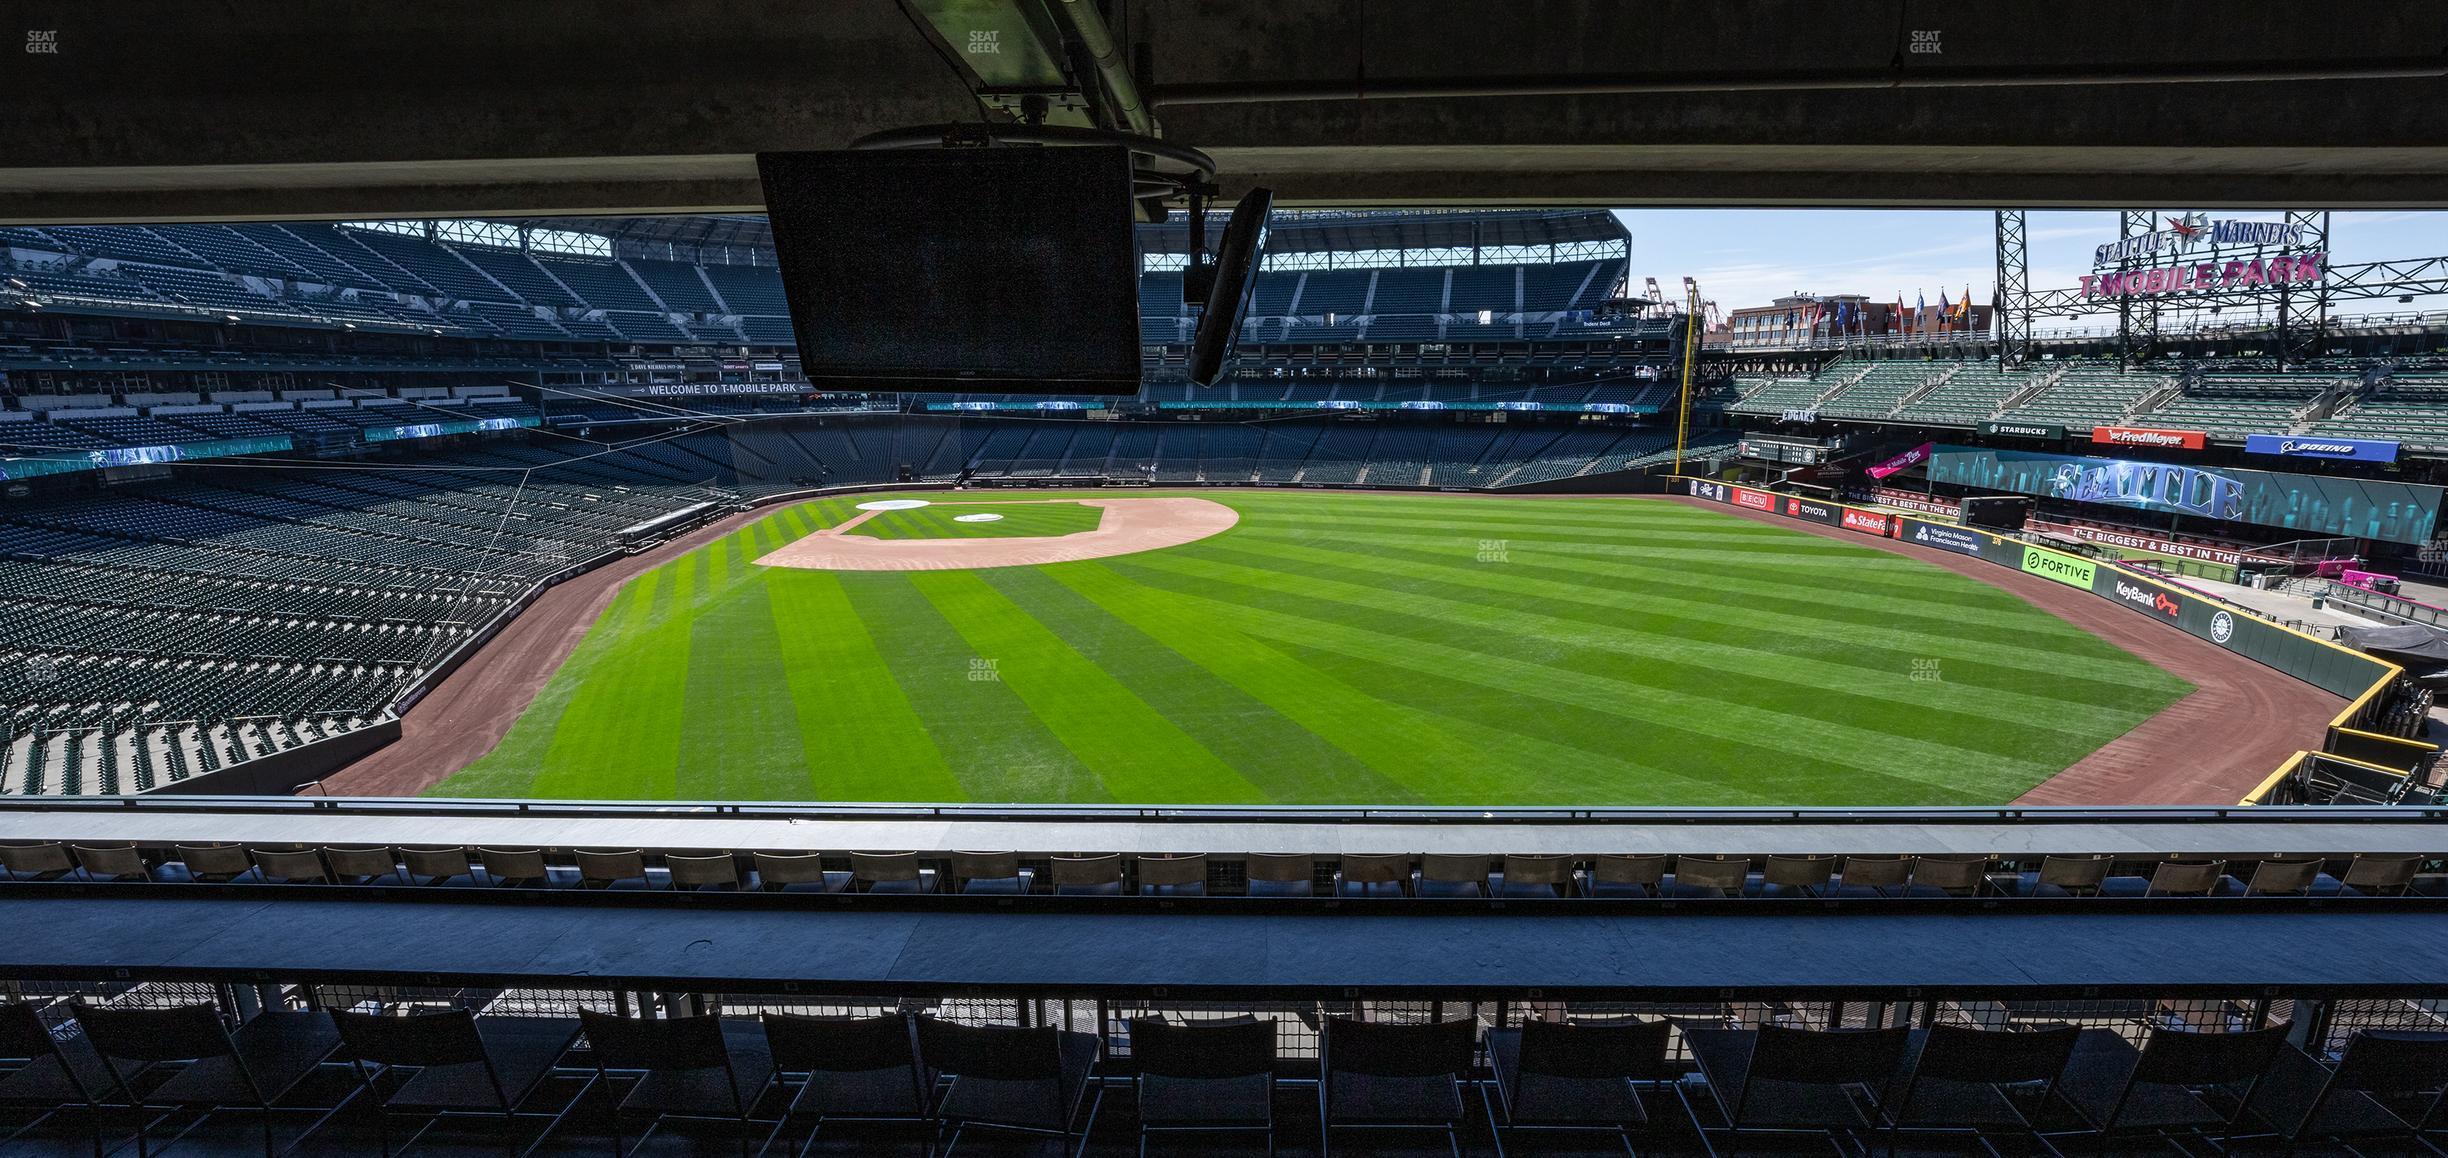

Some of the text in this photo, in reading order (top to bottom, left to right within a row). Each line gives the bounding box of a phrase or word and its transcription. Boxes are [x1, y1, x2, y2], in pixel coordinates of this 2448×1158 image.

[2095, 218, 2305, 265] SEATTLE MARINERS
[2079, 251, 2330, 298] T-MOBILE PARK
[649, 384, 796, 395] WELCOME TO T-MOBILE PARK
[2000, 425, 2048, 436] STARBUCKS
[2299, 442, 2354, 453] BOEING
[1741, 493, 1766, 505] BECU
[1801, 504, 1828, 517] TOYOTA
[1899, 500, 1918, 510] BEST
[1929, 505, 1945, 514] THE
[1931, 528, 1973, 542] Virginia Mason
[1930, 535, 1979, 551] Franciscan Health
[2072, 528, 2093, 540] THE
[2096, 531, 2145, 549] BIGGEST
[2148, 541, 2157, 550] &
[2160, 544, 2193, 556] BEST
[2196, 549, 2211, 560] IN
[2214, 551, 2240, 565] THE
[2041, 559, 2090, 582] FORTIVE
[2116, 580, 2155, 608] KeyBank
